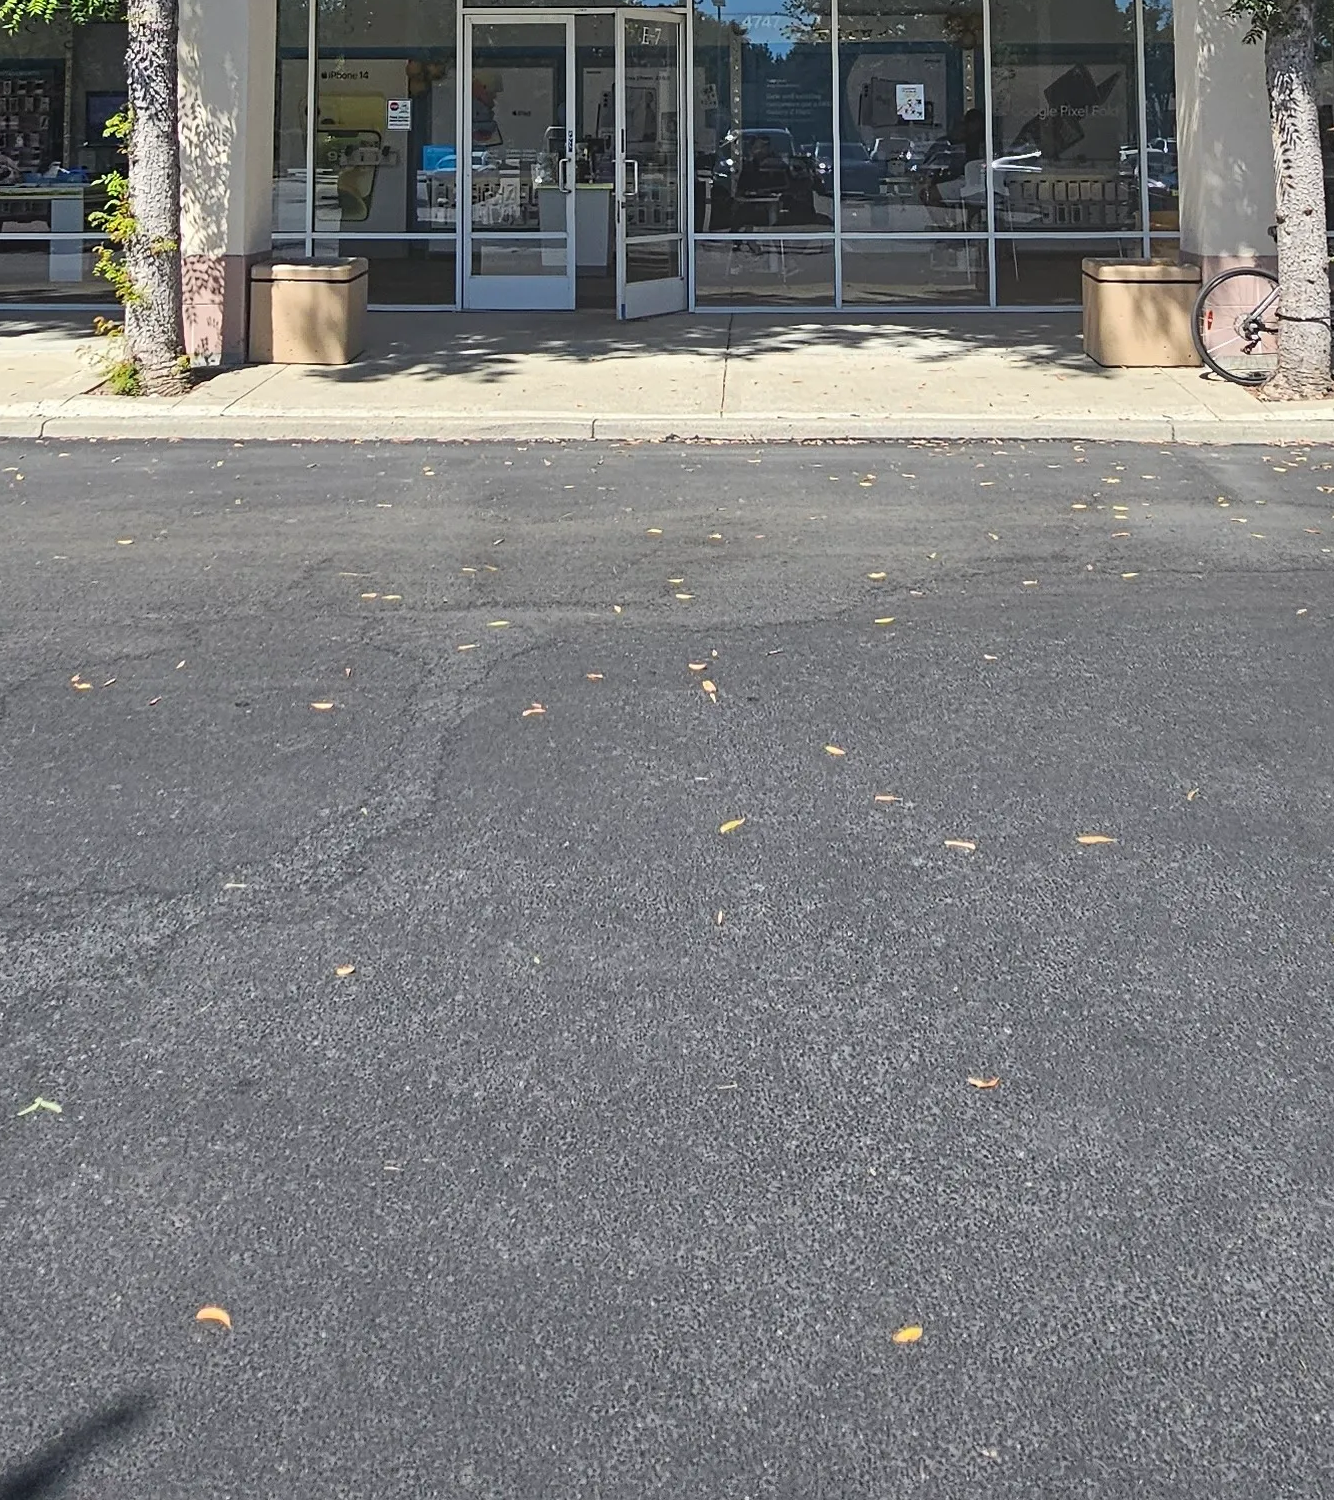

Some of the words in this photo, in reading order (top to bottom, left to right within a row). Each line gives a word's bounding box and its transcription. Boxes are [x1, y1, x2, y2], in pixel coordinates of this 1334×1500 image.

[641, 26, 662, 45] E-7
[328, 70, 358, 80] iPhone
[359, 71, 369, 79] 14
[1060, 104, 1088, 117] Pixel
